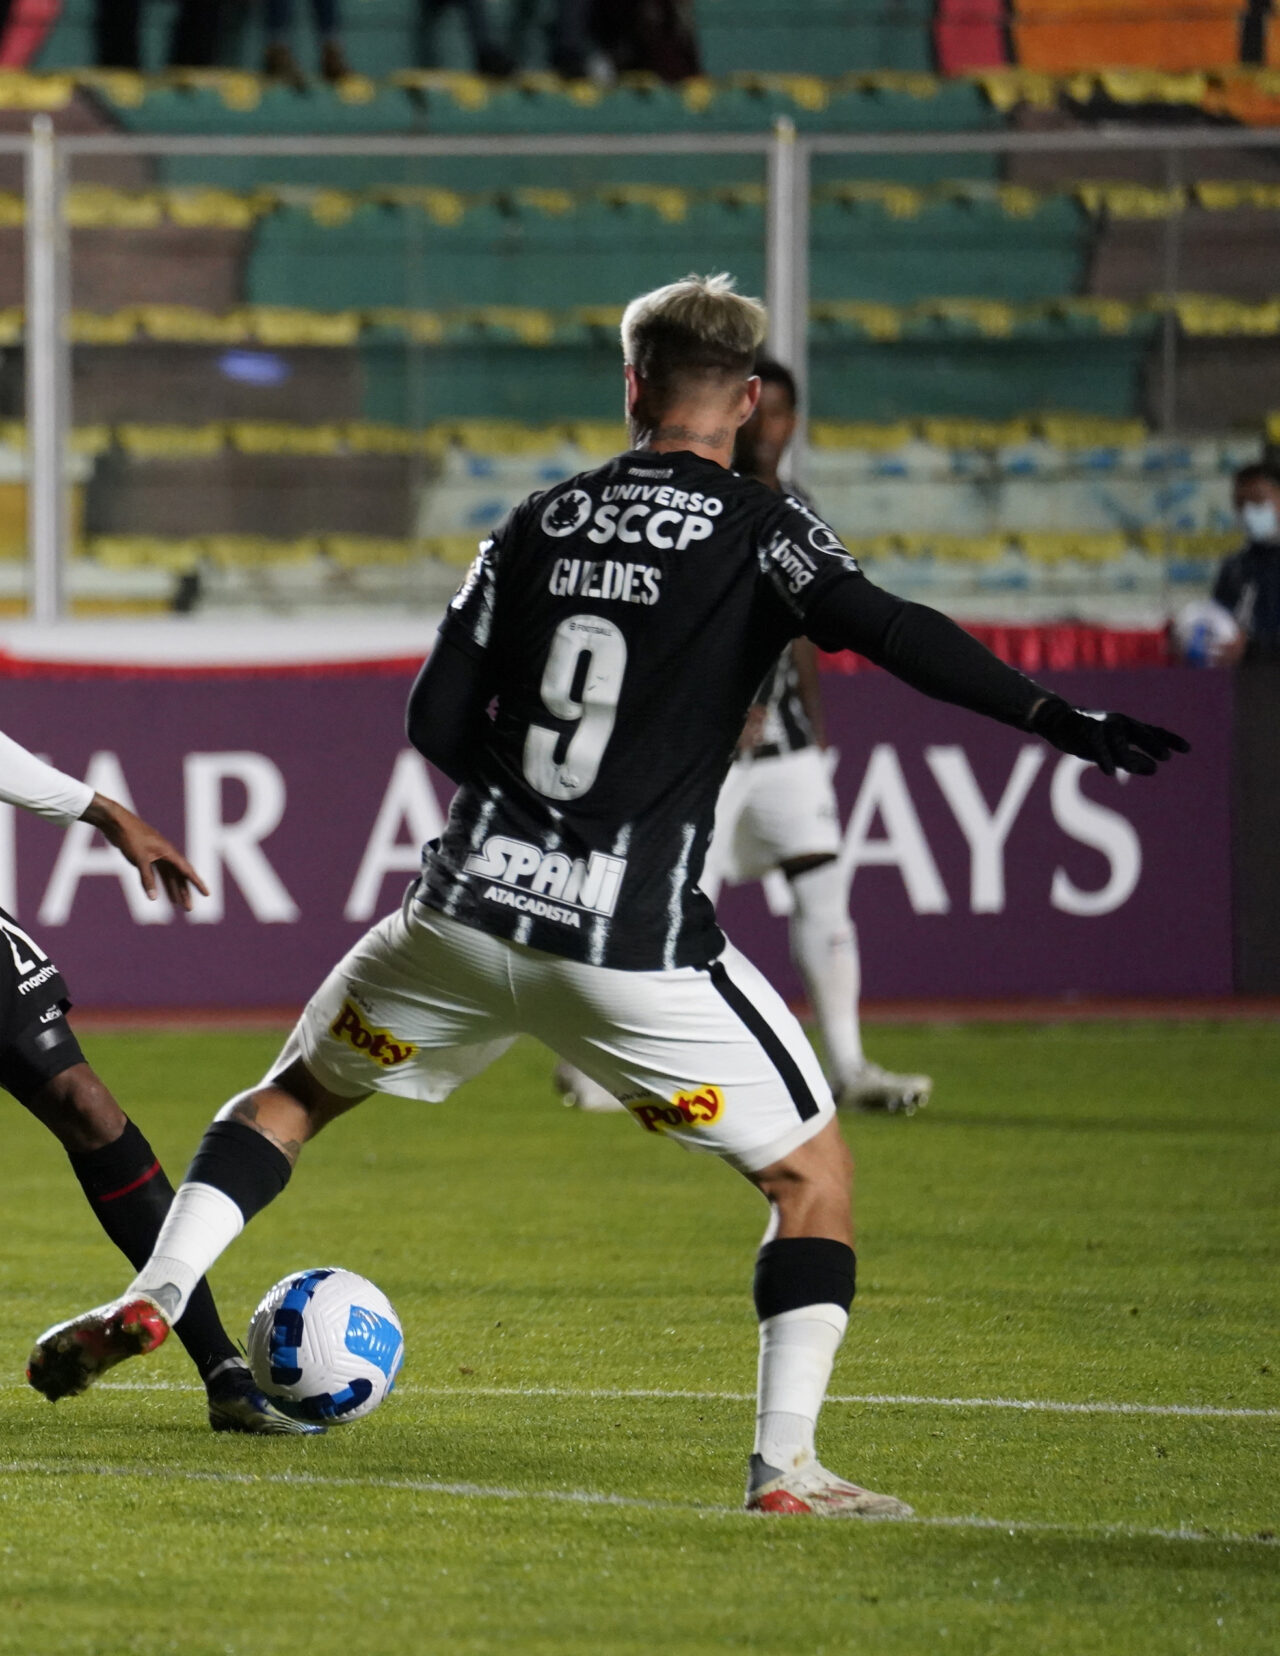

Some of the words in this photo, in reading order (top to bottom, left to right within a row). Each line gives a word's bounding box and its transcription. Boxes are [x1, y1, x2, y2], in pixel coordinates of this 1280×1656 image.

[601, 483, 724, 517] UNIVERSO
[586, 503, 714, 551] SCCP
[548, 557, 663, 606] GUEDES
[770, 537, 815, 594] bmg
[522, 614, 628, 801] 9
[483, 885, 581, 929] ATACADISTA
[332, 1003, 413, 1065] Poty
[633, 1088, 719, 1132] Poty
